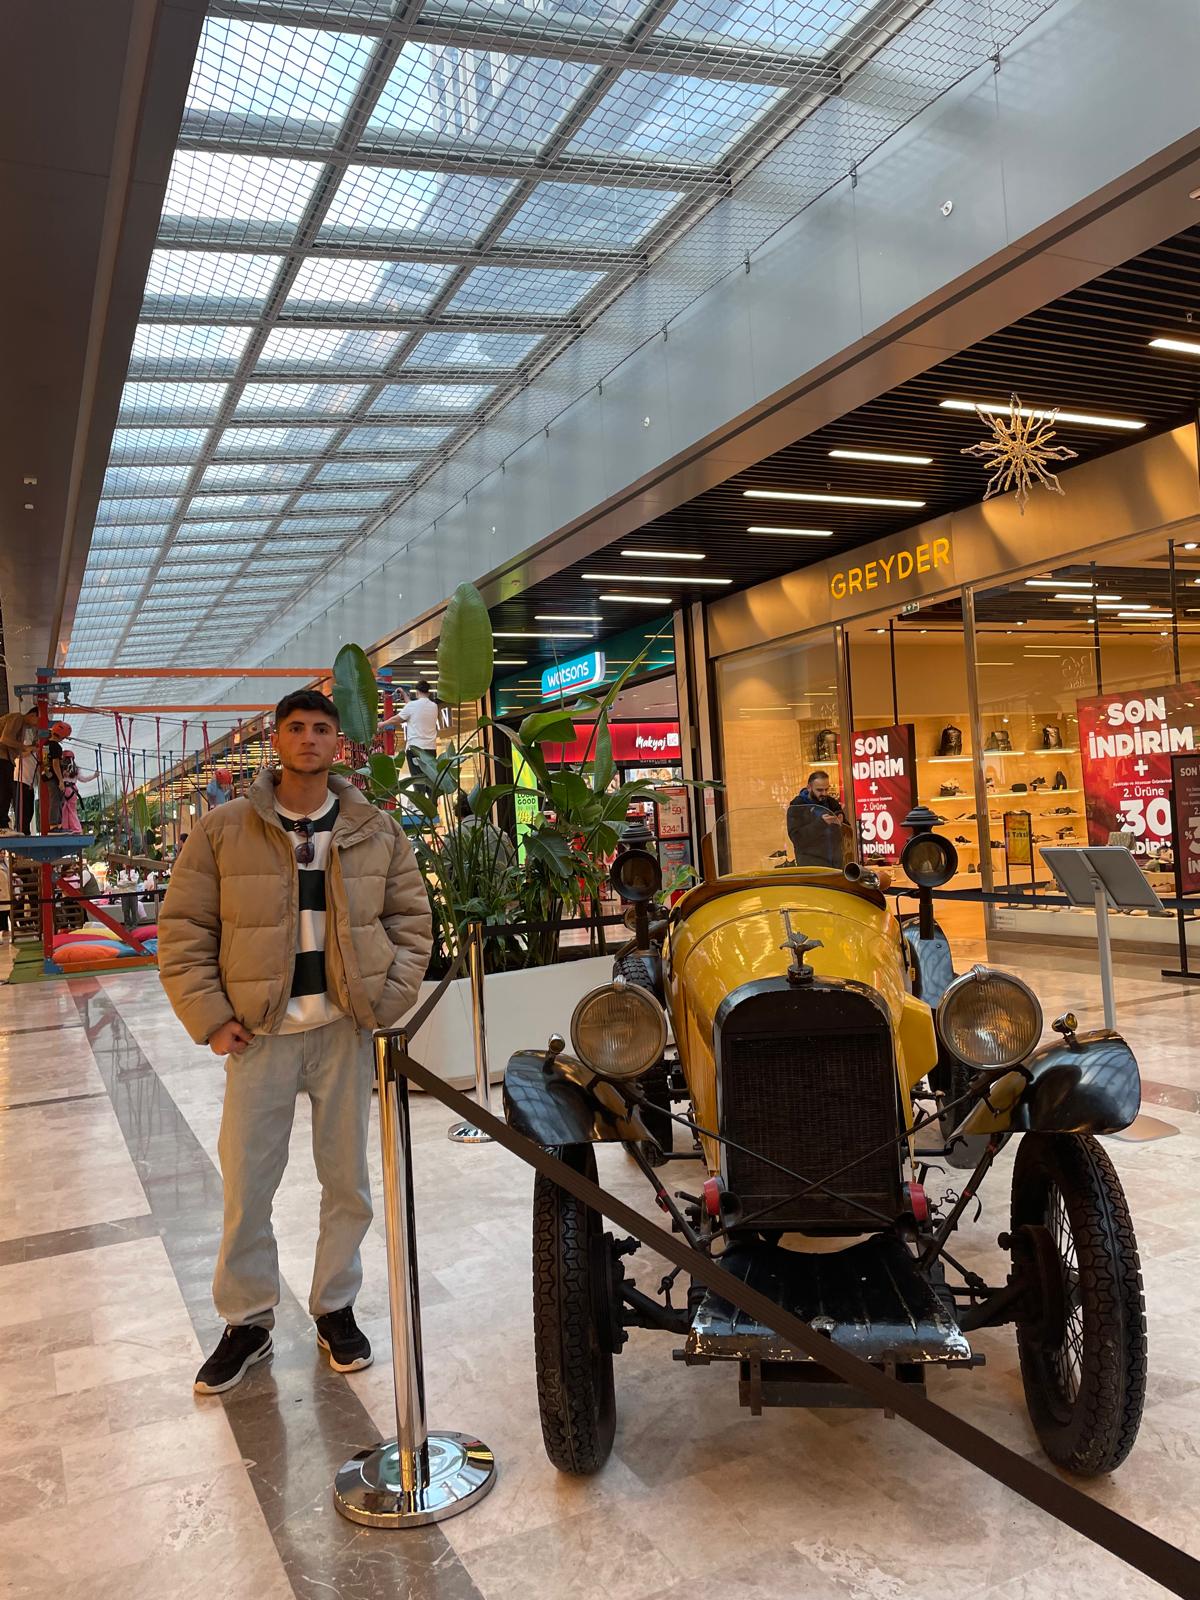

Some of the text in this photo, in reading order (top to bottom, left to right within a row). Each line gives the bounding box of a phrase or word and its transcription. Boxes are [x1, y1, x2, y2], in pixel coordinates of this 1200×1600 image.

[831, 537, 950, 600] GREYDER
[547, 661, 589, 688] watsons
[1107, 697, 1167, 726] SON
[635, 735, 667, 751] Makyaj
[854, 735, 889, 757] SON
[1088, 723, 1194, 760] İNDİRİM
[852, 754, 905, 780] NDİRİM
[1180, 767, 1198, 777] SON
[1123, 785, 1165, 798] 2. Ürüne
[861, 811, 894, 841] 30
[863, 841, 895, 855] NDİRİM
[1130, 837, 1172, 855] DİRİ
